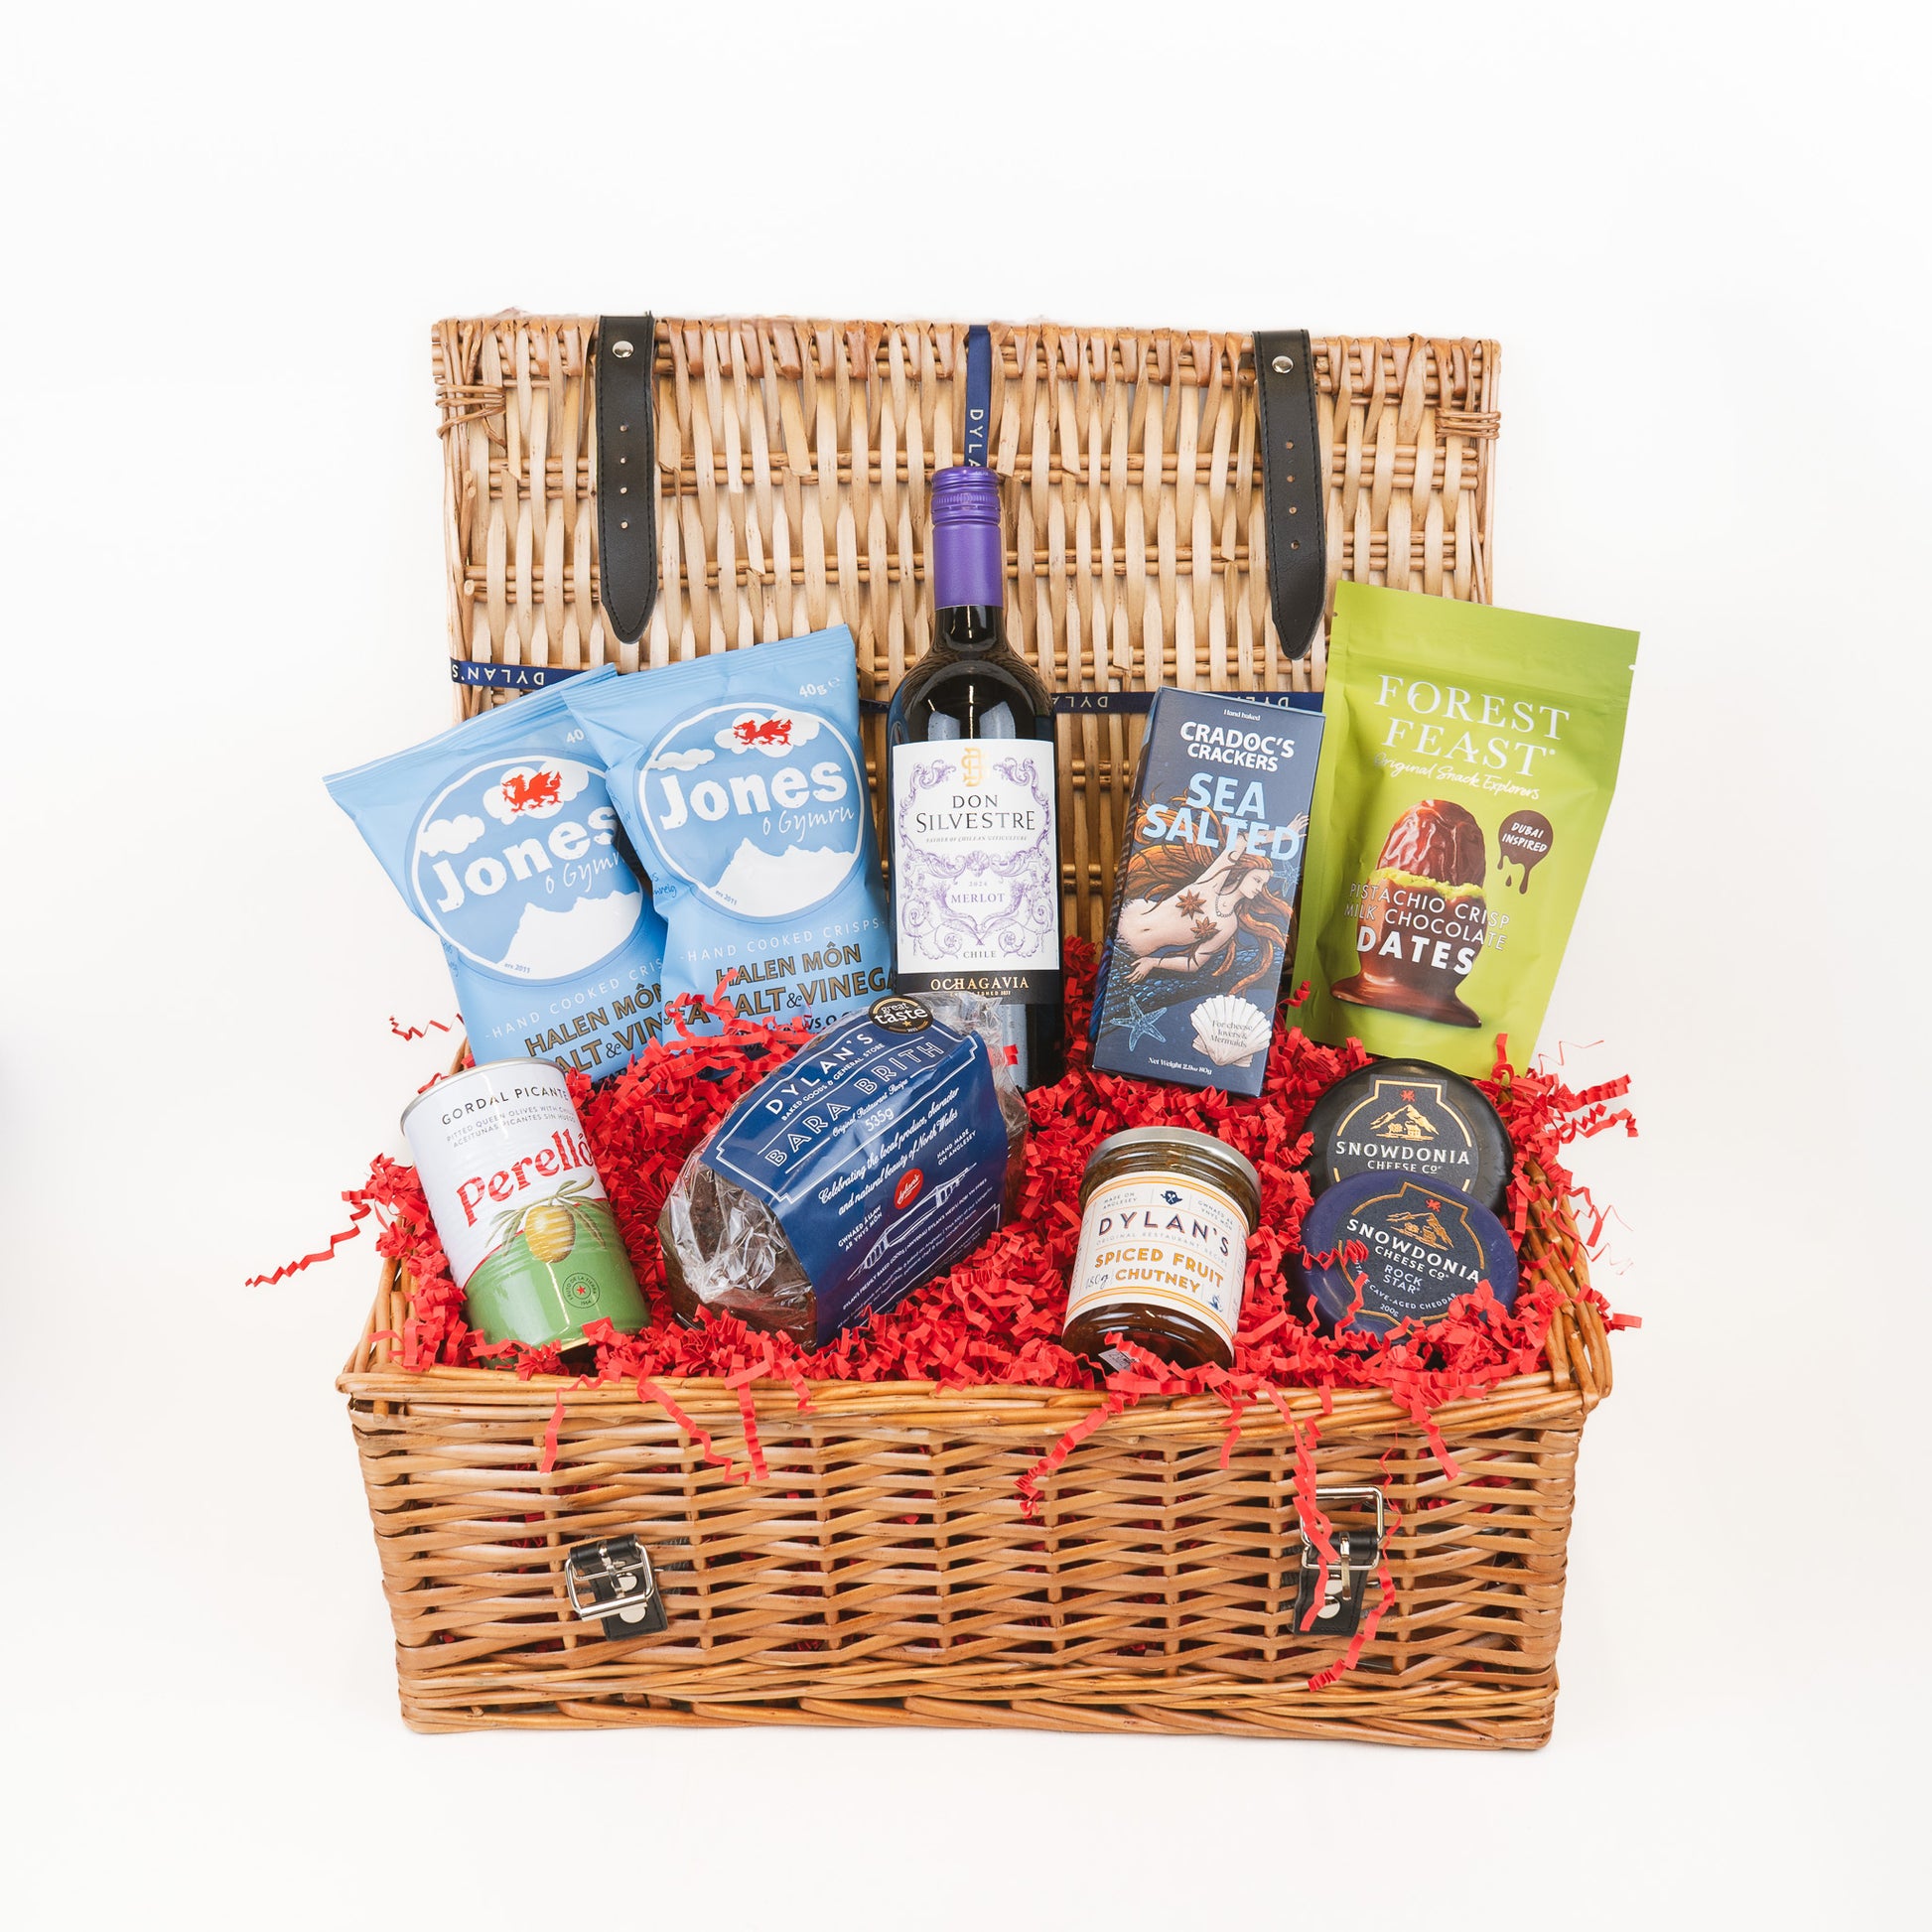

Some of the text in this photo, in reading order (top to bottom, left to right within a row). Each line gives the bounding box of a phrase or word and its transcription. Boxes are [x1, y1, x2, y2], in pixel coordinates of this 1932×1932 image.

[452, 664, 545, 685] DYLAN'S
[798, 683, 826, 697] 40g
[1223, 709, 1261, 721] Hand baked
[1374, 674, 1571, 741] FOREST
[1180, 721, 1296, 759] CRADOC'S
[1187, 743, 1279, 772] CRACKERS
[1374, 752, 1541, 800] Original Snack Explorers
[659, 761, 847, 830] Jones
[953, 794, 998, 808] DON
[1186, 772, 1266, 820] SEA
[762, 805, 854, 842] o Gymru
[915, 811, 1035, 833] SILVESTRE
[1142, 803, 1300, 861] SALTED
[1511, 822, 1545, 840] DUBAI
[1501, 833, 1548, 854] INSPIRED
[432, 806, 616, 913] Jones
[563, 853, 624, 892] Gymr
[951, 894, 1005, 903] MERLOT
[1350, 883, 1511, 929] PISTACHIO CRISP
[1344, 902, 1509, 951] MILK CHOCOLATE
[748, 930, 813, 953] COOKED
[1356, 925, 1477, 977] DATES
[716, 941, 862, 987] HALEN MÔN
[550, 978, 620, 1015] COOKED
[931, 977, 1029, 991] OCHAGAVIA
[874, 1009, 928, 1025] taste
[882, 1003, 909, 1014] great
[524, 1007, 610, 1056] HALEN
[1211, 1035, 1247, 1048] Mermaids
[1218, 1029, 1241, 1038] lovers
[554, 1038, 602, 1073] ALT
[1160, 1058, 1181, 1069] Weight
[765, 1033, 874, 1116] DYLAN'S
[781, 1100, 802, 1121] BAKED
[802, 1084, 828, 1102] GOODS
[834, 1057, 864, 1080] GENERAL
[863, 1042, 886, 1057] STORE
[441, 1086, 569, 1126] GORDAL PICANTE
[765, 1041, 945, 1168] BARA BRITH
[832, 1076, 909, 1137] Original Restaurant Recipe
[447, 1124, 473, 1142] PITTED
[476, 1113, 506, 1128] QUEEN
[508, 1106, 538, 1116] OLIVES
[453, 1124, 498, 1148] ACEITUNAS
[502, 1114, 542, 1126] PICANTES
[866, 1108, 895, 1132] 535g
[818, 1166, 866, 1204] Celebrating
[867, 1152, 880, 1170] the
[880, 1132, 899, 1160] local
[927, 1087, 959, 1119] character
[936, 1128, 970, 1160] HAND MADE
[937, 1130, 977, 1166] ON ANGLESEY
[1335, 1142, 1470, 1166] SNOWDONIA
[838, 1108, 959, 1216] and natural beauty of North Wales
[1367, 1160, 1418, 1173] CHEESE
[1103, 1197, 1137, 1209] ANGLESEY
[1197, 1200, 1225, 1218] GWNAED
[838, 1221, 864, 1247] GWNAED
[846, 1241, 854, 1251] AR
[853, 1227, 870, 1245] YNYS
[1096, 1233, 1136, 1246] ORIGINAL
[1142, 1231, 1199, 1249] RESTAURANT
[1098, 1211, 1229, 1257] DYLAN'S
[1346, 1218, 1480, 1284] SNOWDONIA
[1374, 1246, 1425, 1273] CHEESE
[877, 1261, 891, 1277] BAKED
[1094, 1247, 1164, 1269] SPICED
[1173, 1253, 1224, 1289] FRUIT
[1115, 1269, 1200, 1295] CHUTNEY
[1384, 1264, 1424, 1287] ROCK
[1370, 1285, 1417, 1310] CAVE-AGED
[1420, 1293, 1456, 1311] CHEDDAR
[1382, 1275, 1416, 1295] STAR
[1380, 1303, 1400, 1317] 200g
